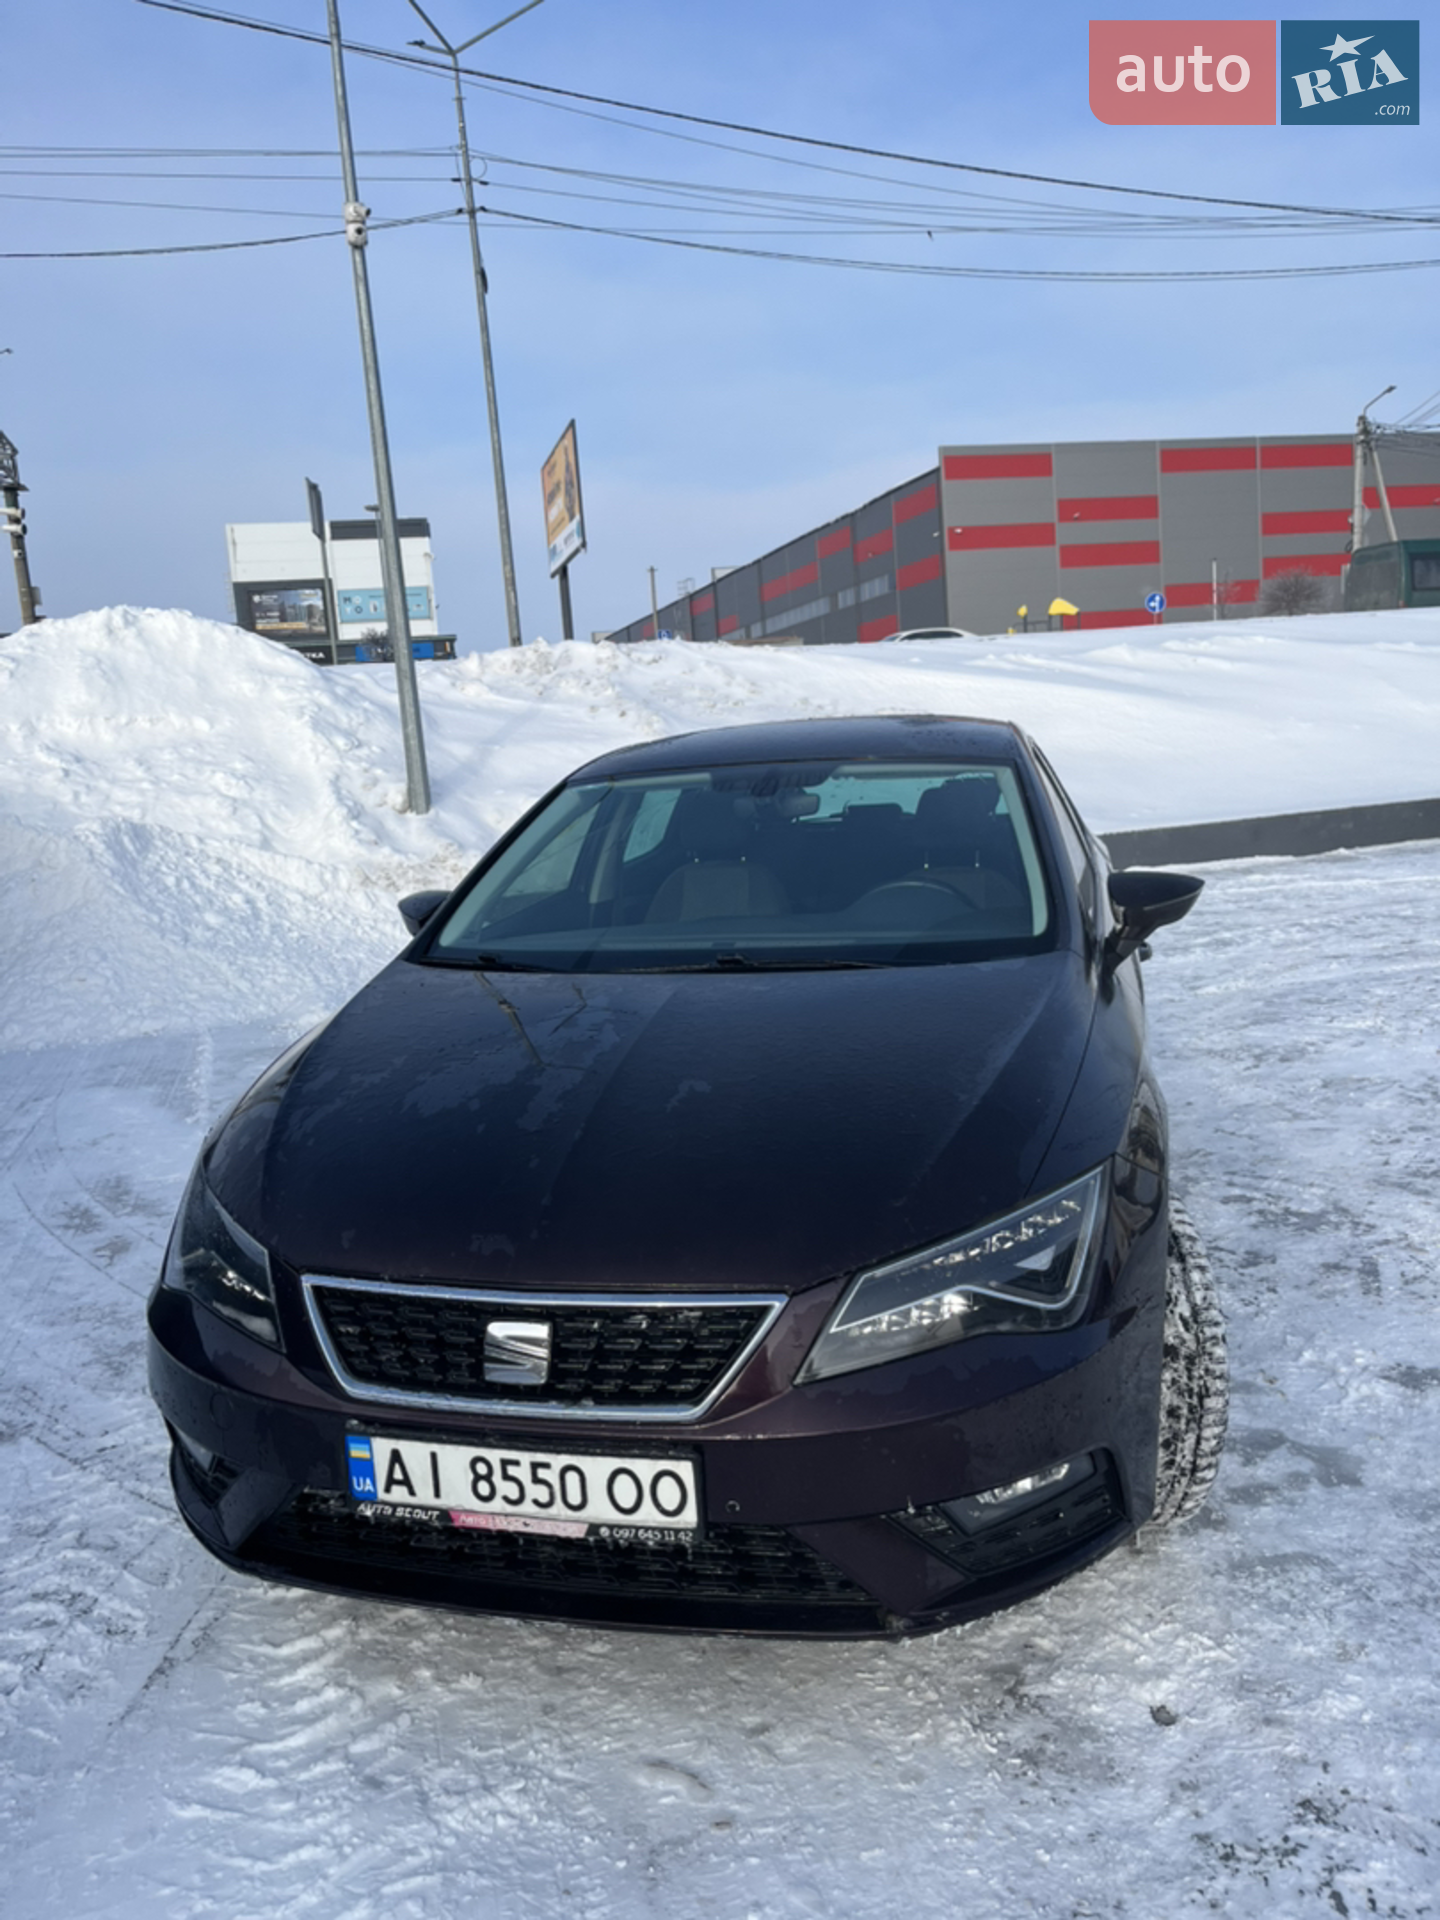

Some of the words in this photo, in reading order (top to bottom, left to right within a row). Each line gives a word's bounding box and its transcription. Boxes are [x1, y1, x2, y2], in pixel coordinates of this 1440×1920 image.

[352, 1476, 375, 1493] UA
[383, 1448, 441, 1499] AI
[469, 1455, 588, 1512] 8550
[606, 1467, 688, 1518] OO
[357, 1502, 392, 1516] AUTO
[395, 1506, 440, 1520] SCOUT
[613, 1527, 635, 1539] 097
[664, 1530, 675, 1541] 11
[677, 1530, 693, 1541] 42
